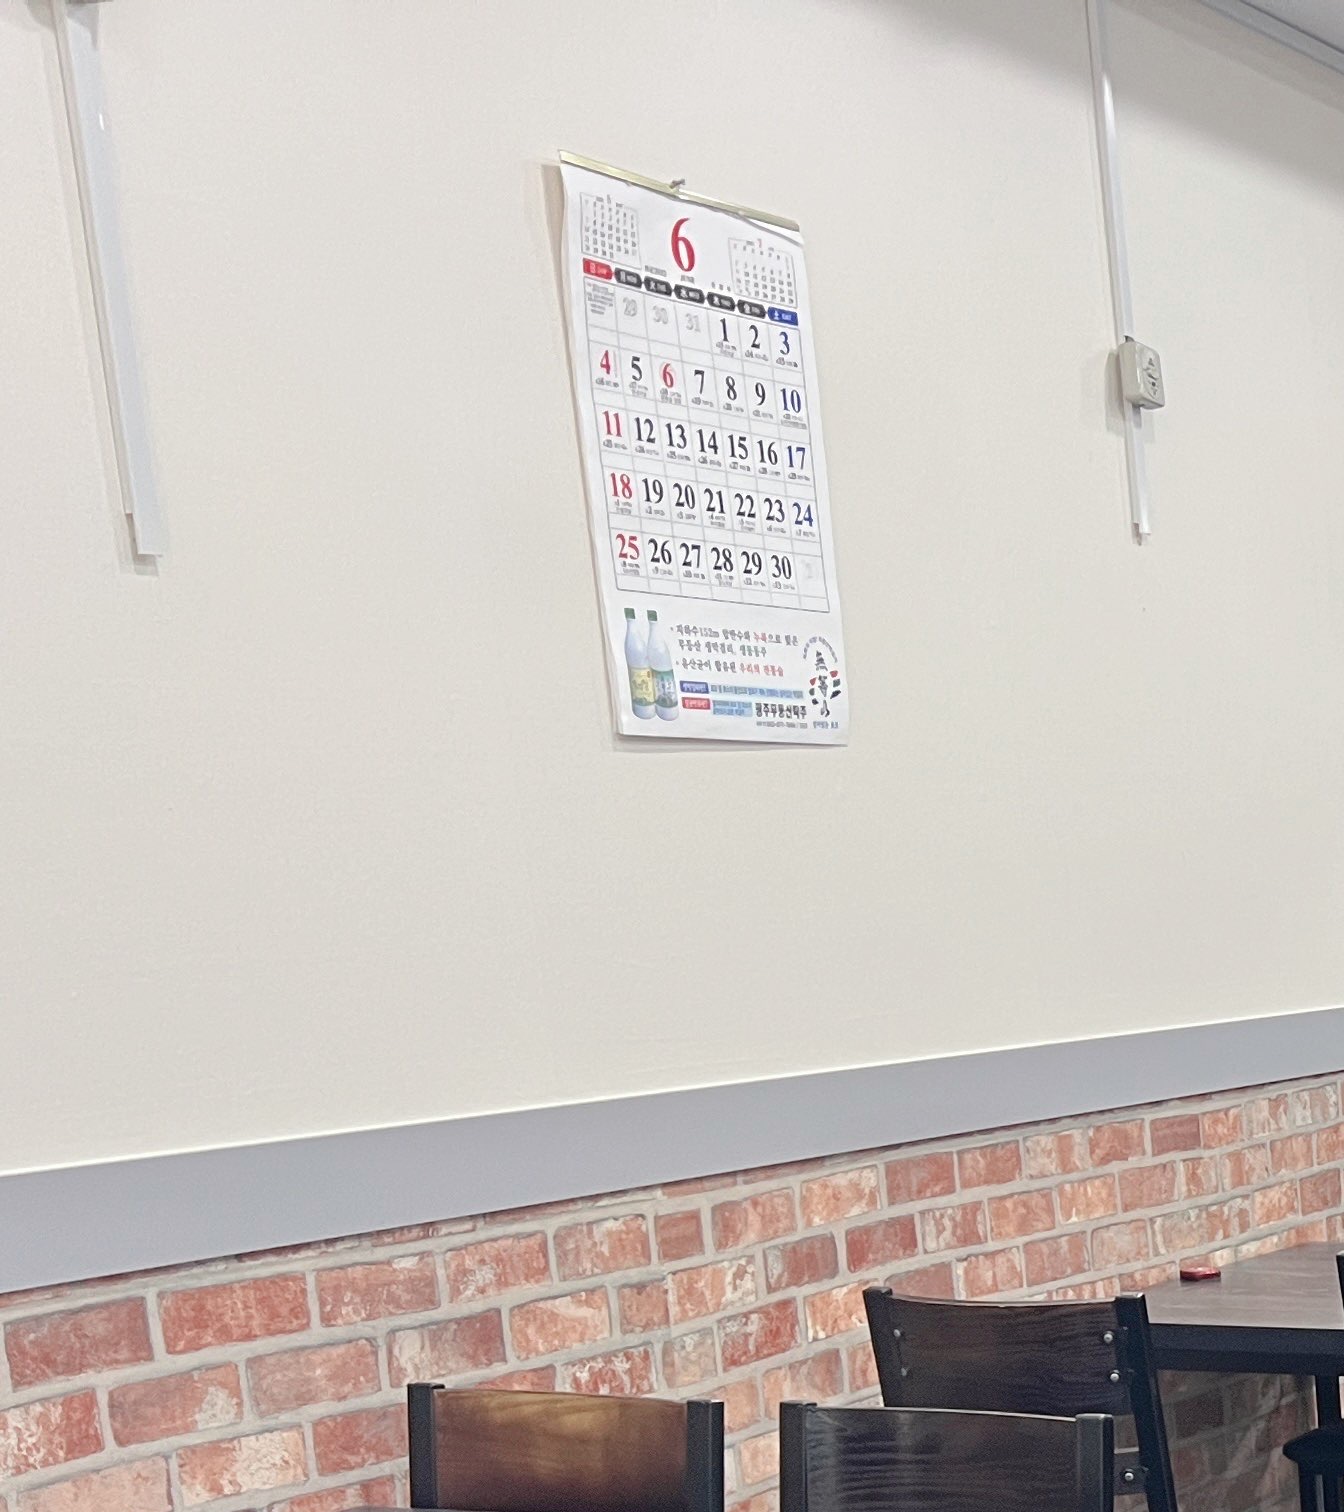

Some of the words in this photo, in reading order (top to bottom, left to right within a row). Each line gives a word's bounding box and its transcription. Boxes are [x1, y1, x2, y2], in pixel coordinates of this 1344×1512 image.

[671, 217, 696, 272] 6
[719, 318, 729, 342] 1
[749, 324, 761, 349] 2
[779, 331, 790, 355] 3
[600, 349, 611, 375] 4
[631, 356, 643, 382] 5
[662, 362, 675, 388] 6
[694, 369, 705, 395] 7
[725, 375, 738, 401] 8
[755, 382, 766, 406] 9
[780, 387, 801, 413] 10
[602, 410, 622, 437] 11
[634, 416, 656, 444] 12
[665, 422, 687, 449] 13
[697, 428, 719, 455] 14
[728, 434, 749, 461] 15
[756, 440, 778, 466] 16
[786, 445, 806, 470] 17
[610, 472, 633, 499] 18
[641, 477, 664, 504] 19
[672, 482, 696, 510] 20
[703, 487, 724, 514] 21
[734, 493, 756, 519] 22
[763, 497, 785, 523] 23
[792, 502, 814, 527] 24
[616, 532, 640, 560] 25
[647, 537, 672, 565] 26
[680, 542, 701, 569] 27
[711, 547, 733, 573] 28
[740, 550, 762, 576] 29
[770, 555, 792, 580] 30
